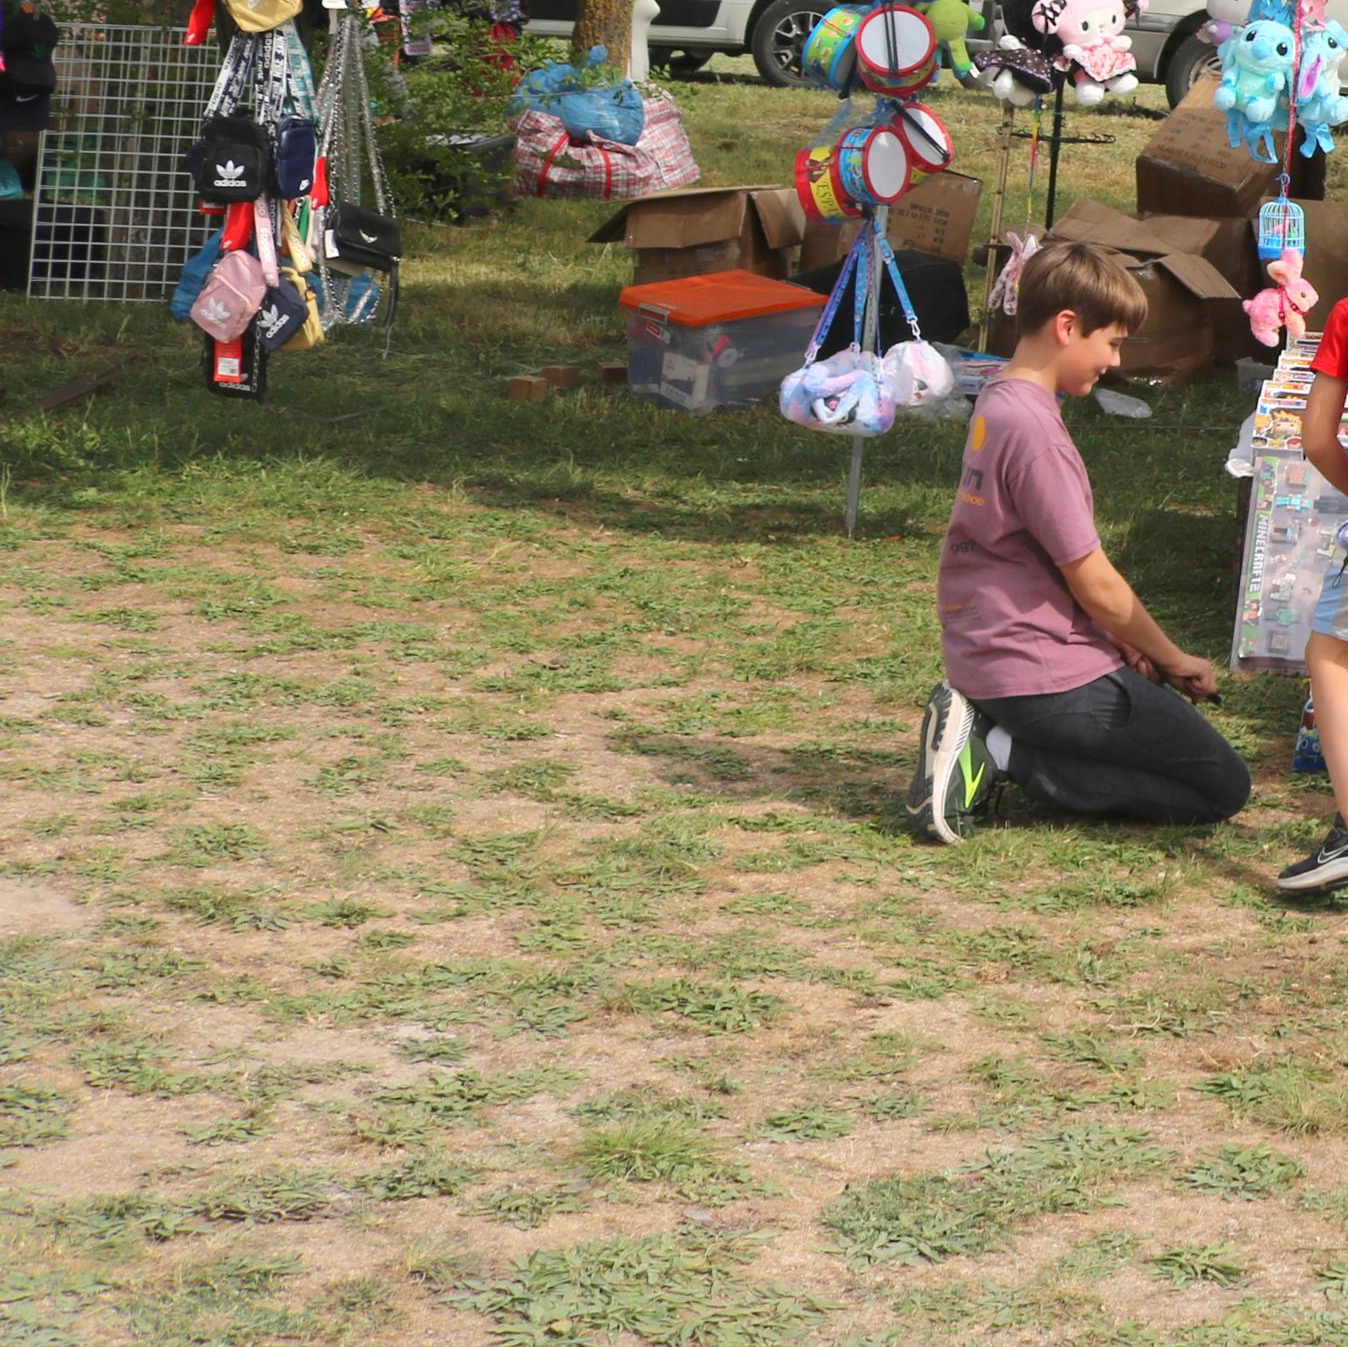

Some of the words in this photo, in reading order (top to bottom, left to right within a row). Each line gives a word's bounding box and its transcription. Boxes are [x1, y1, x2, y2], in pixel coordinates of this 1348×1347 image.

[263, 33, 273, 69] adidas
[213, 179, 247, 187] adidas
[266, 313, 290, 339] adidas
